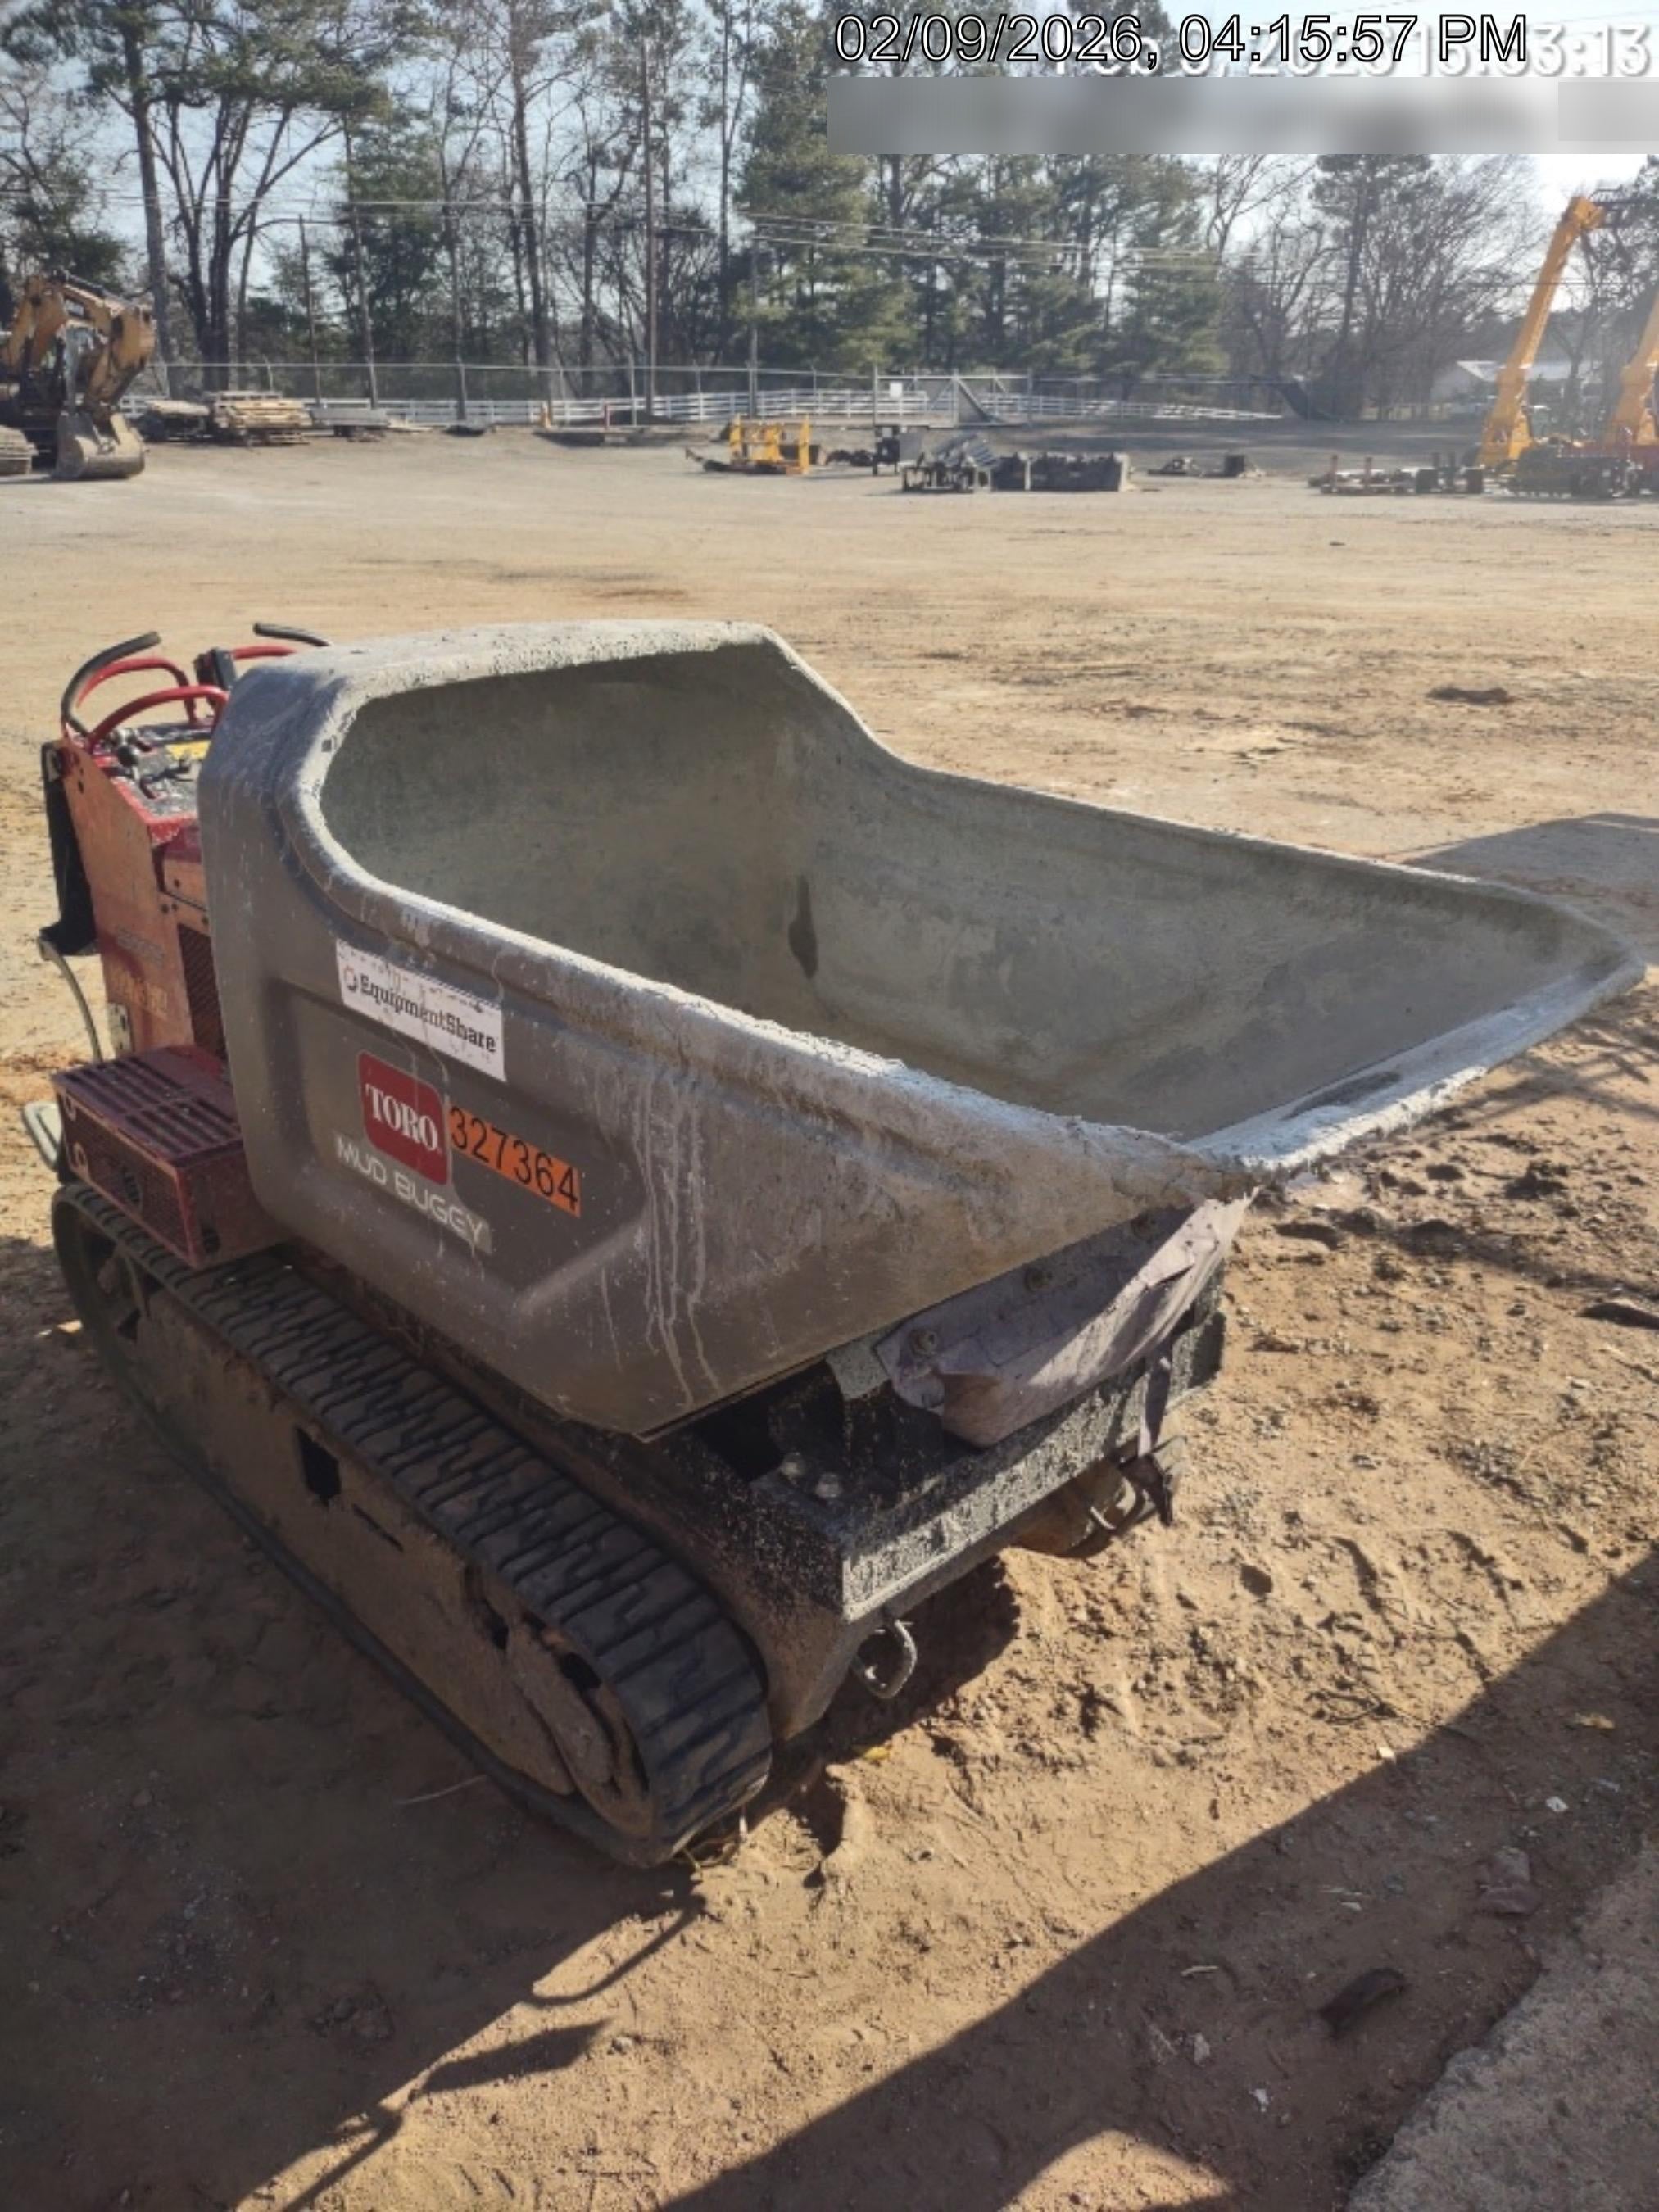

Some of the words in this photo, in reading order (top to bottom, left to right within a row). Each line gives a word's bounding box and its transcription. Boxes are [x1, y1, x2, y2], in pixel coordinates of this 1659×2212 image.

[360, 972, 497, 1054] EquipmentShare
[365, 1083, 439, 1152] TORO
[449, 1105, 578, 1210] 327364
[337, 1135, 387, 1185] MUD
[394, 1171, 483, 1242] BUGGY
